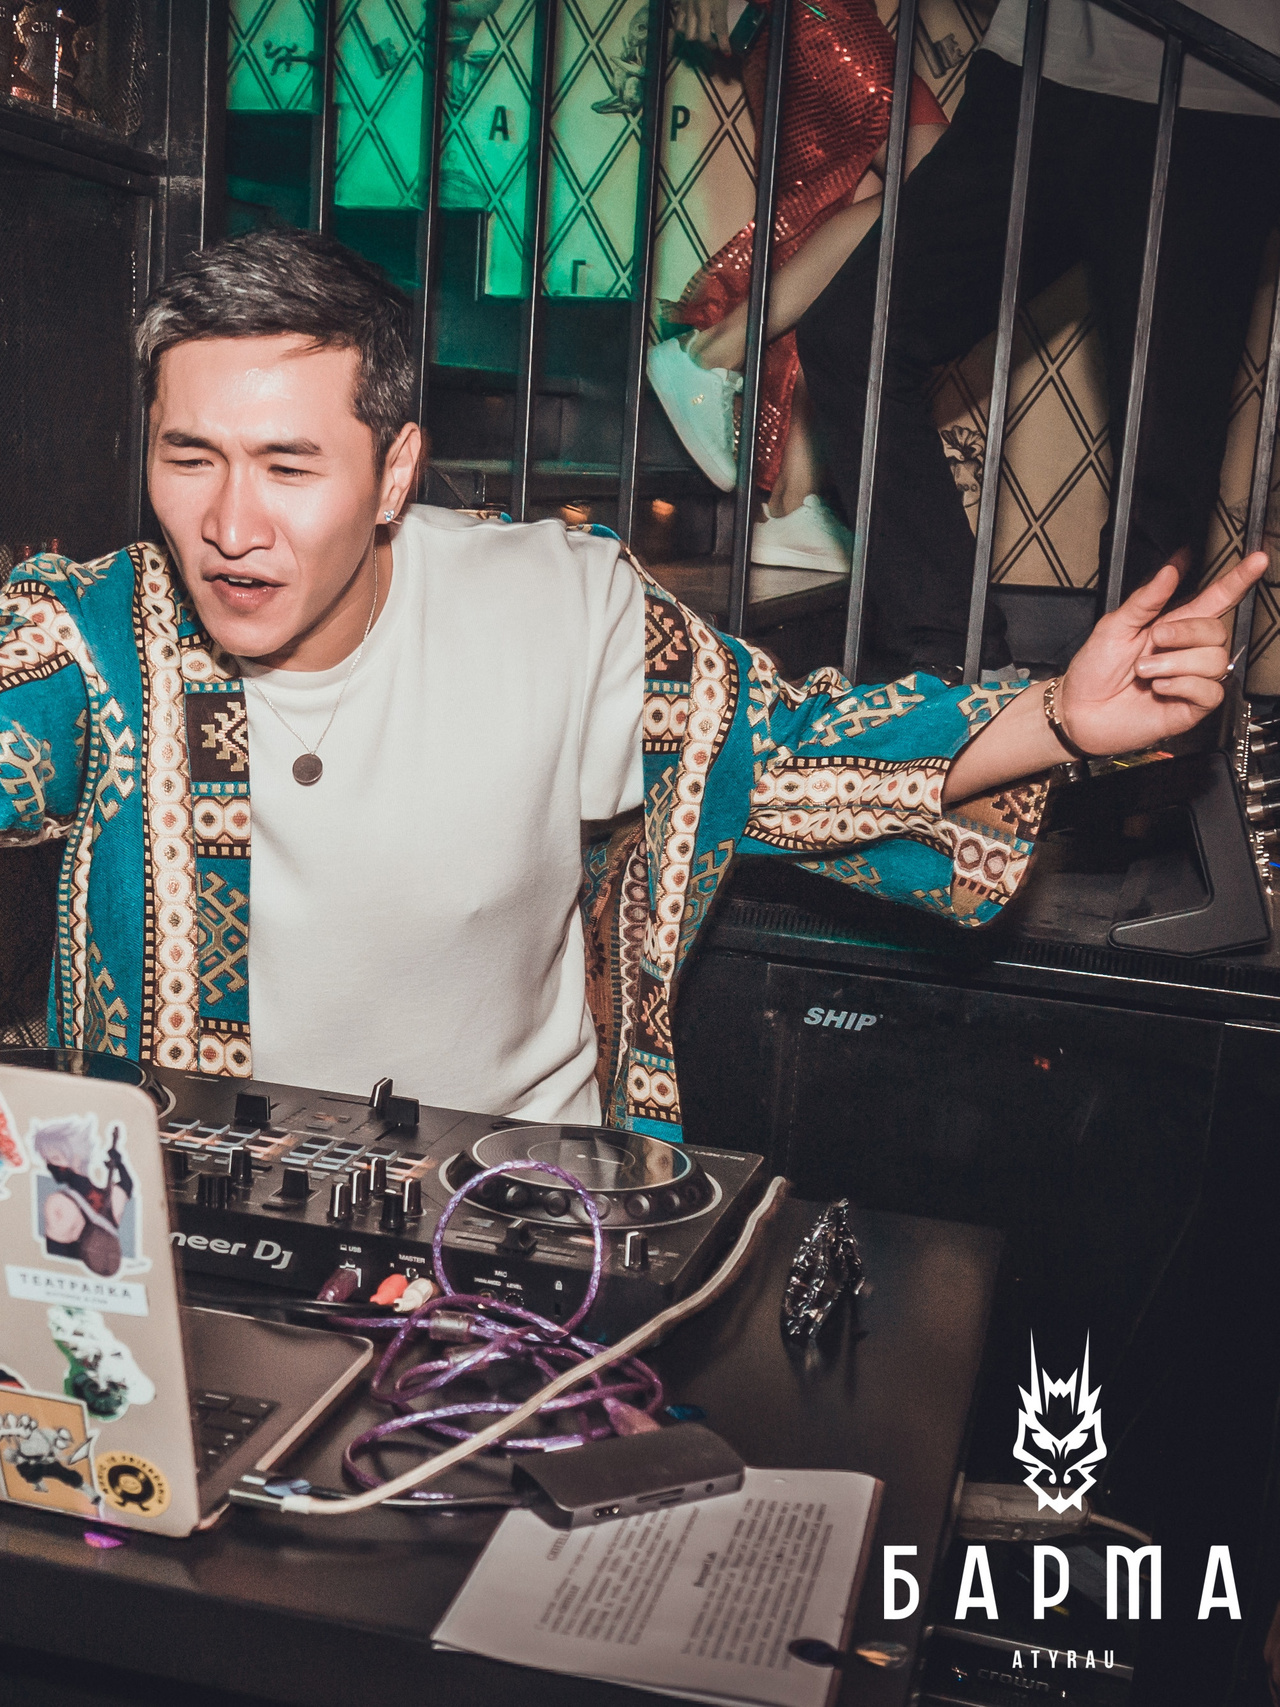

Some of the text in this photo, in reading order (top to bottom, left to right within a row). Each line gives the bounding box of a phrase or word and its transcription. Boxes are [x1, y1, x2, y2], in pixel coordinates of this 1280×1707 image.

[488, 105, 510, 141] А
[670, 105, 691, 142] Р
[803, 1007, 878, 1032] SHIP
[169, 1231, 247, 1256] neer
[348, 1245, 362, 1254] USB
[398, 1253, 426, 1264] MASTER
[494, 1270, 508, 1278] MIC
